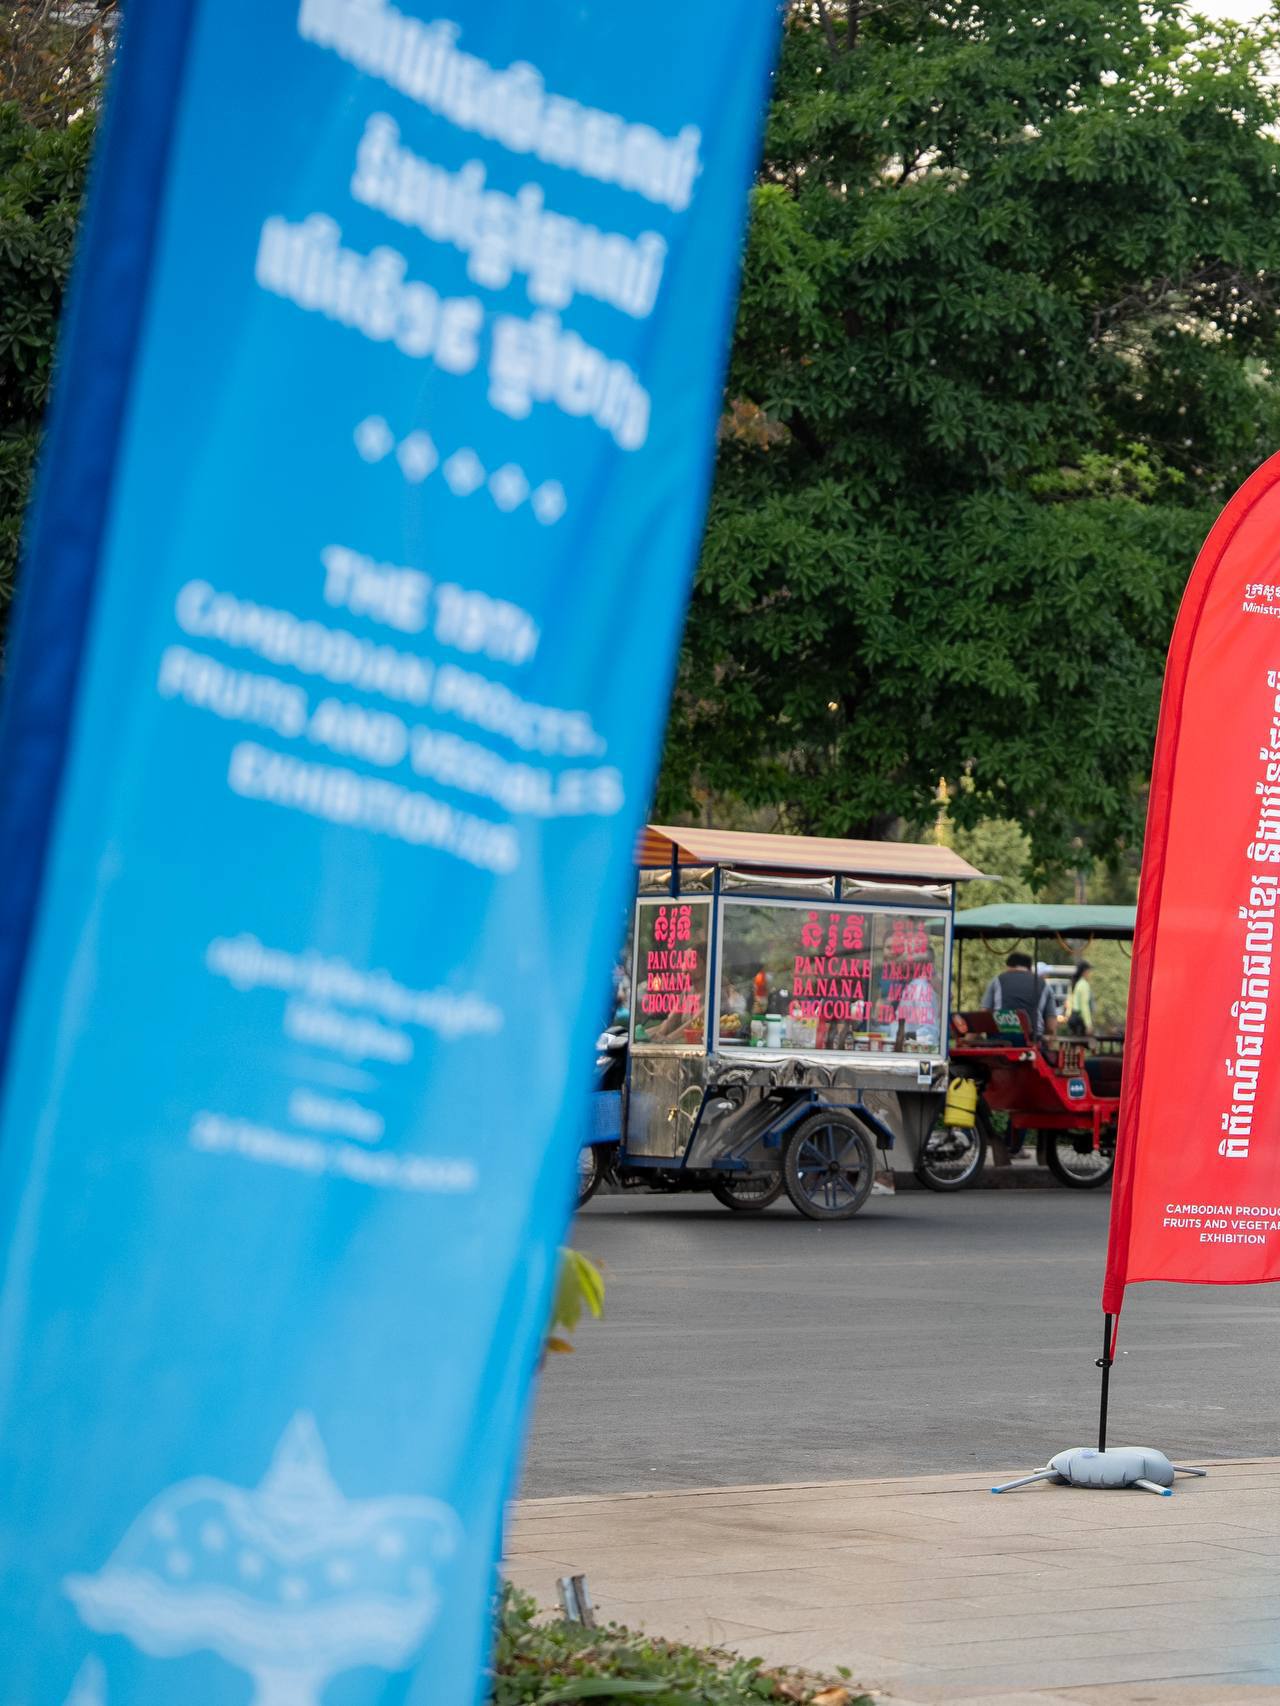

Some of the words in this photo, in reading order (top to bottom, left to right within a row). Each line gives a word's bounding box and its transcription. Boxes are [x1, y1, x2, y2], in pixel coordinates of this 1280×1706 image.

[647, 972, 691, 992] BANANA
[793, 977, 864, 999] BANANA
[994, 1010, 1020, 1025] Grab
[1166, 1204, 1232, 1215] CAMBODIAN
[1163, 1218, 1202, 1228] FRUITS
[1204, 1219, 1228, 1229] AND
[1200, 1233, 1266, 1244] EXHIBITION
